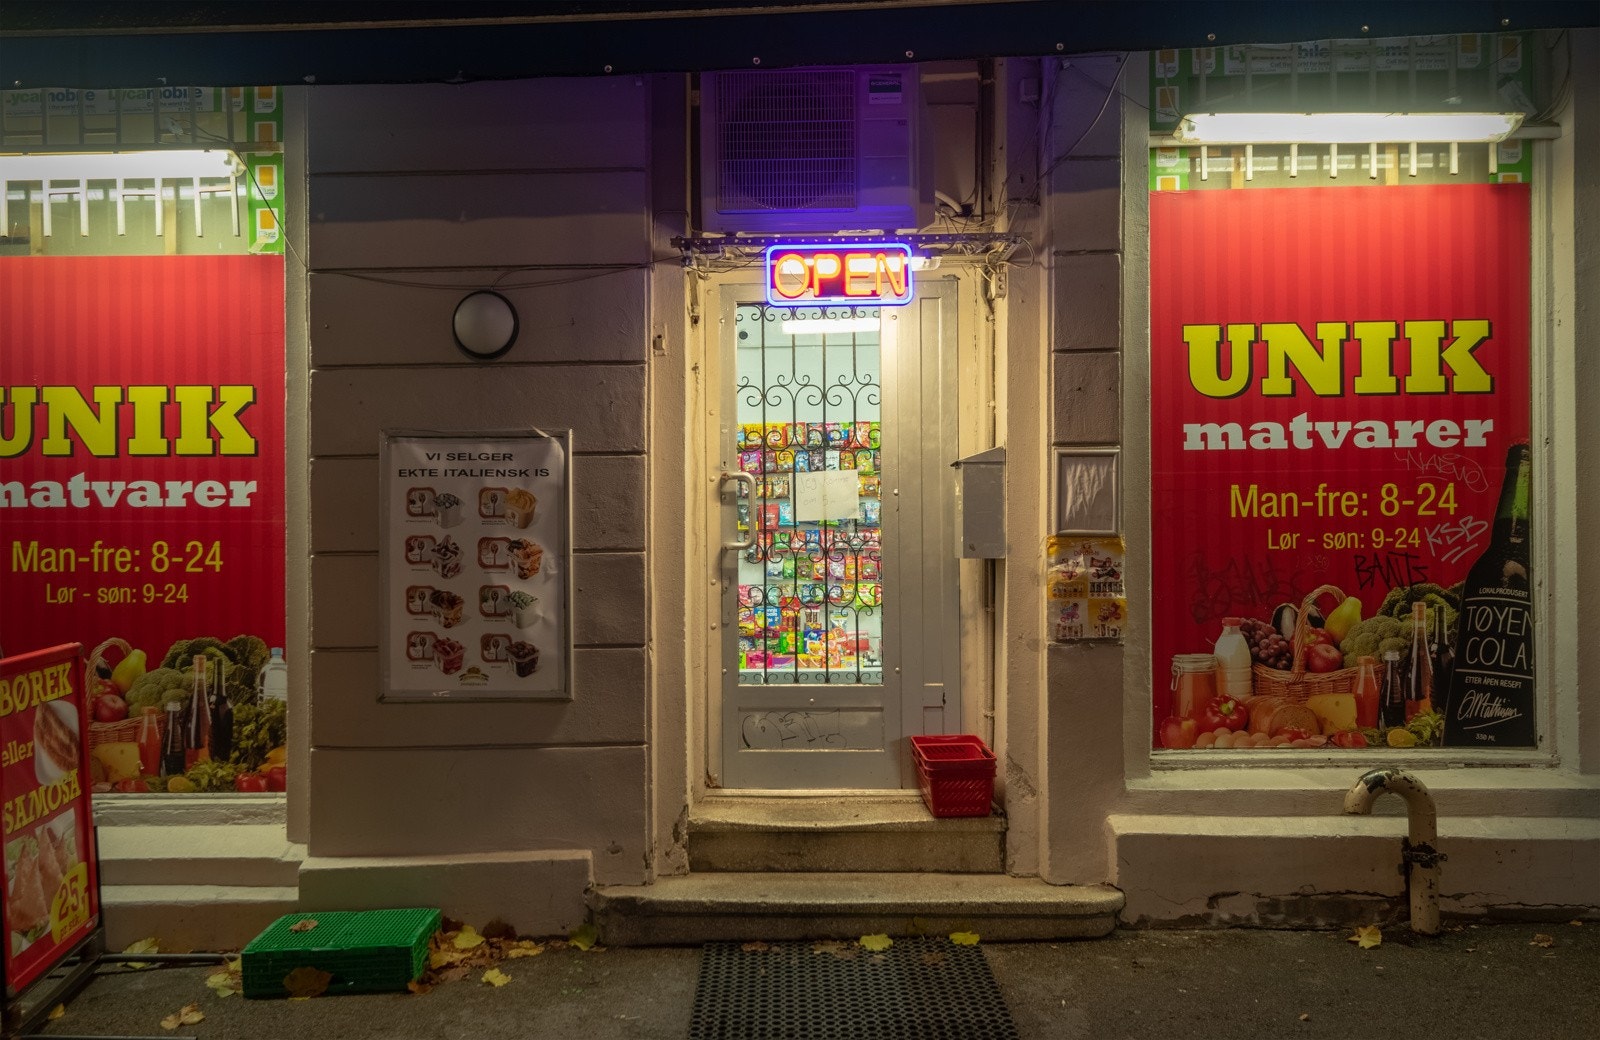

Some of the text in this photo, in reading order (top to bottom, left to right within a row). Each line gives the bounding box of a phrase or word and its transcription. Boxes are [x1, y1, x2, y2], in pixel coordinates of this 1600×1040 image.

[774, 252, 906, 298] OPEN
[1183, 320, 1494, 398] UNIK
[1183, 412, 1494, 451] matvarer
[398, 467, 550, 478] EKTE ITALIENSK IS
[425, 452, 514, 462] VI SELGER
[1230, 483, 1459, 518] Man-fre: 8-24
[1267, 528, 1300, 550] Lør
[1323, 530, 1365, 550] søn:
[1371, 527, 1421, 549] 9-24
[11, 540, 223, 573] Man-fre: 8-24
[46, 583, 76, 604] Lør
[97, 586, 137, 604] søn:
[142, 583, 188, 604] 9-24
[1479, 587, 1529, 598] LOKALPRODUSERT
[1466, 605, 1533, 637] TØYEN
[0, 662, 73, 717] BØREK
[1465, 675, 1522, 688] ETTER ÅPEN RESEPT
[2, 740, 34, 768] eller
[3, 769, 82, 835] SAMOSA
